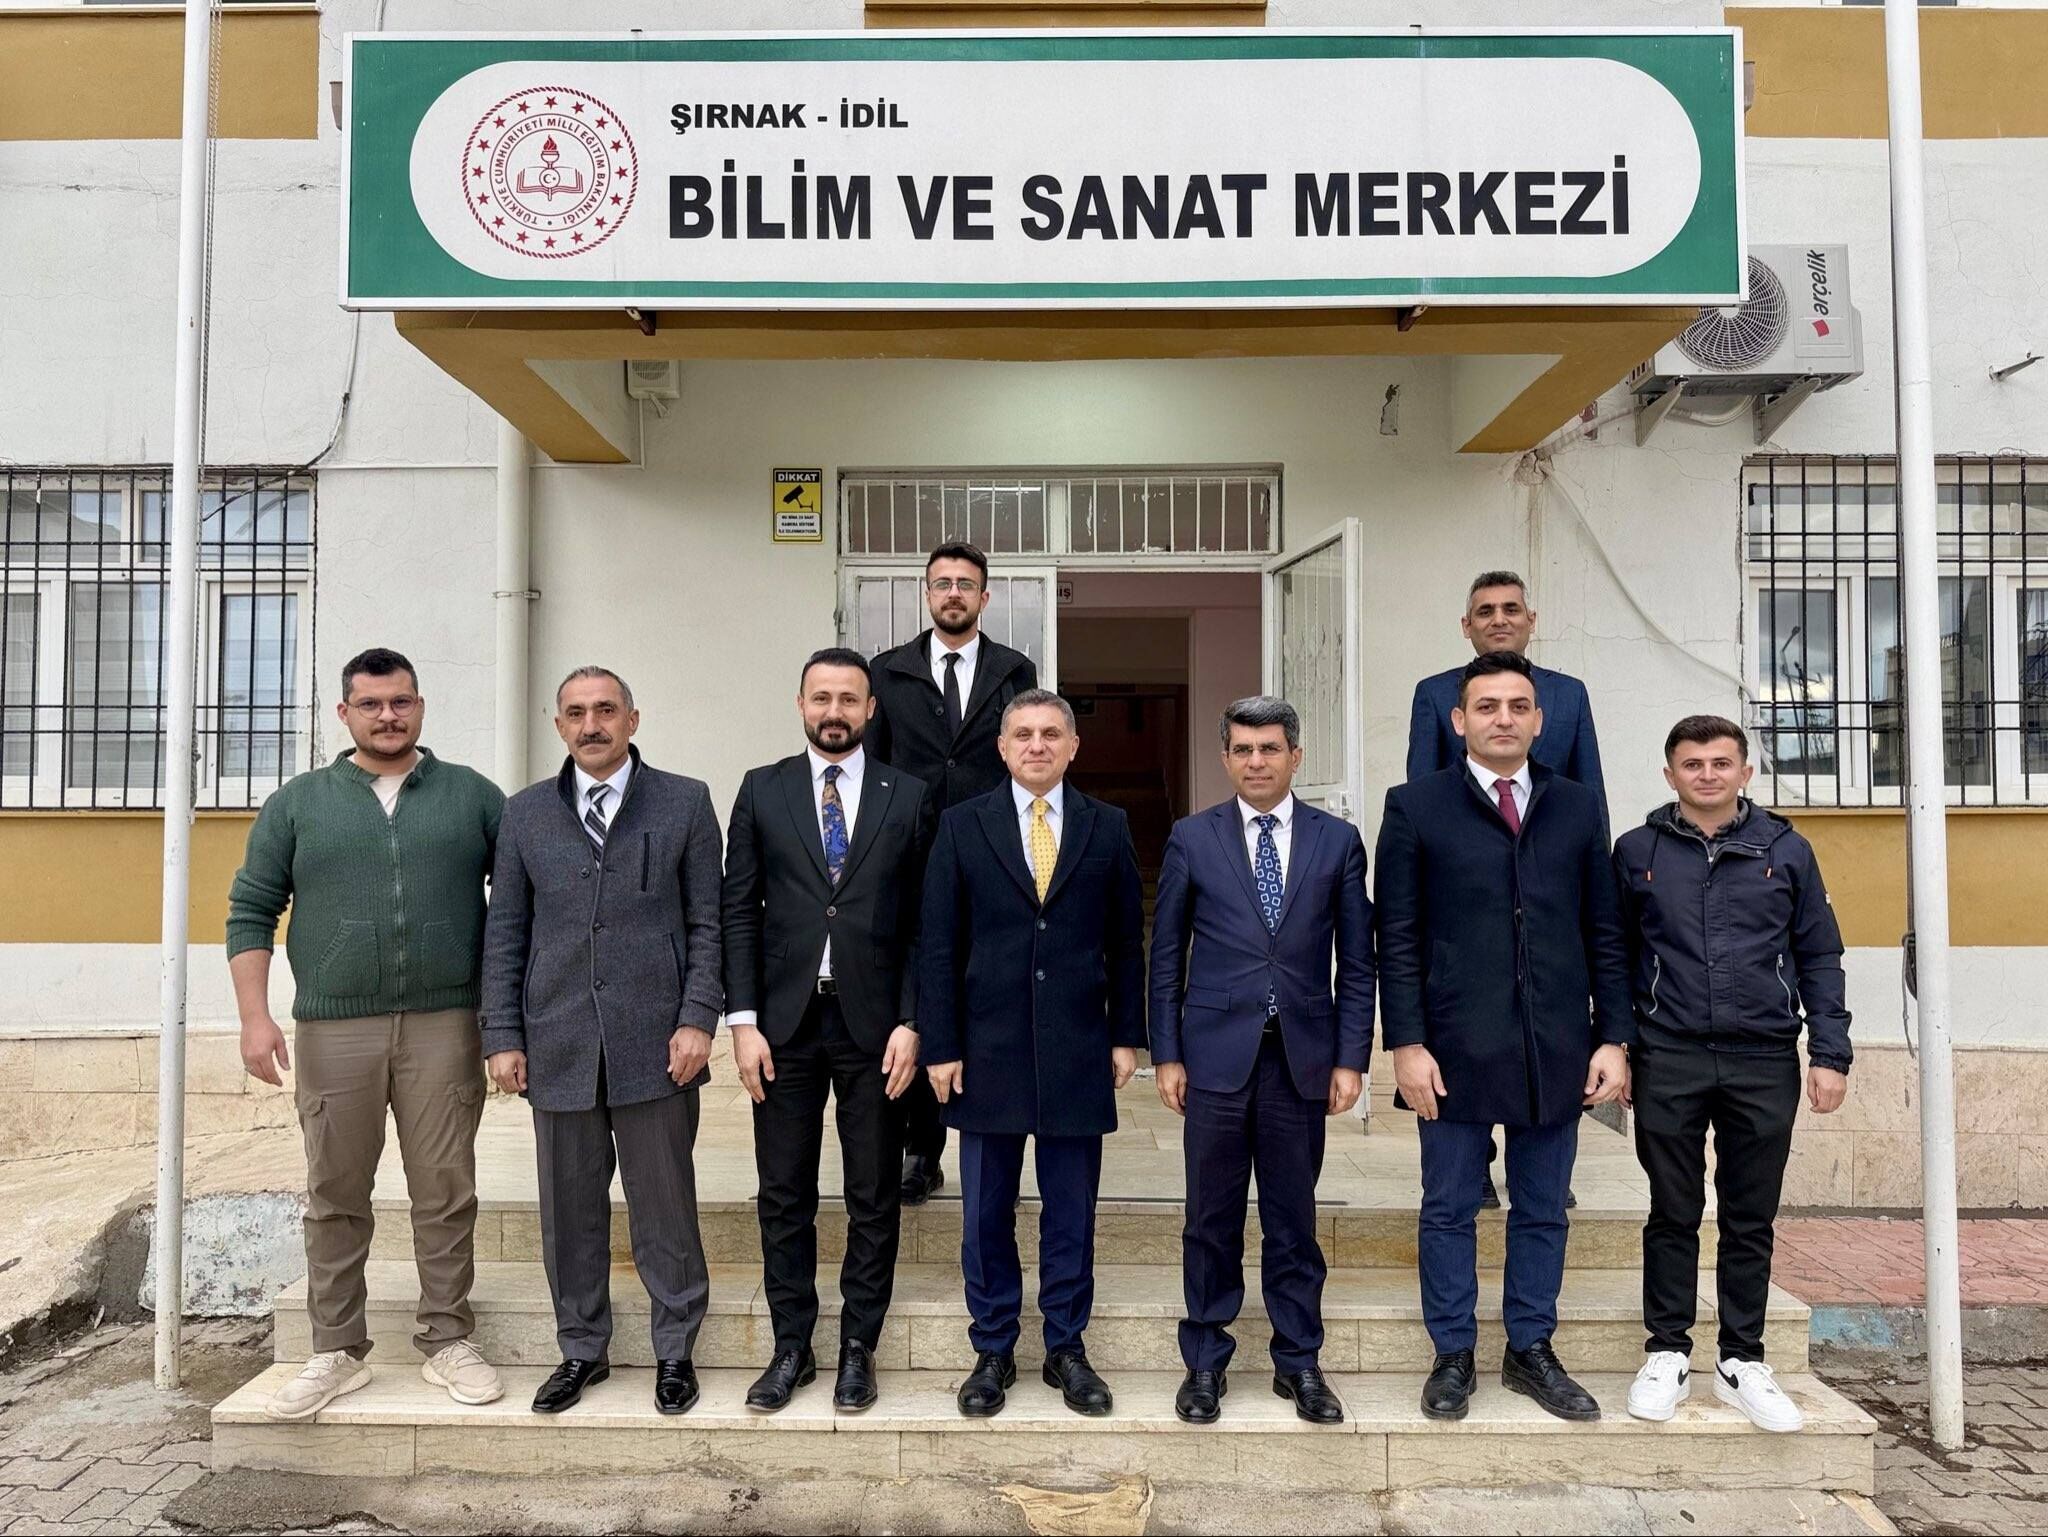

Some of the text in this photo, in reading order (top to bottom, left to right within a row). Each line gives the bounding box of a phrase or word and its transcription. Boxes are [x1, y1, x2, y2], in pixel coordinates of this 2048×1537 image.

[670, 103, 807, 135] ŞIRNAK
[840, 97, 909, 128] İDİL
[494, 117, 606, 225] TÜRKİYE CUMHURİYETİ MİLLİ EĞİTİM BAKANLIĞI
[669, 154, 1630, 241] BİLİM VE SANAT MERKEZİ
[1806, 249, 1832, 316] arçelik
[777, 472, 817, 482] DİKKAT
